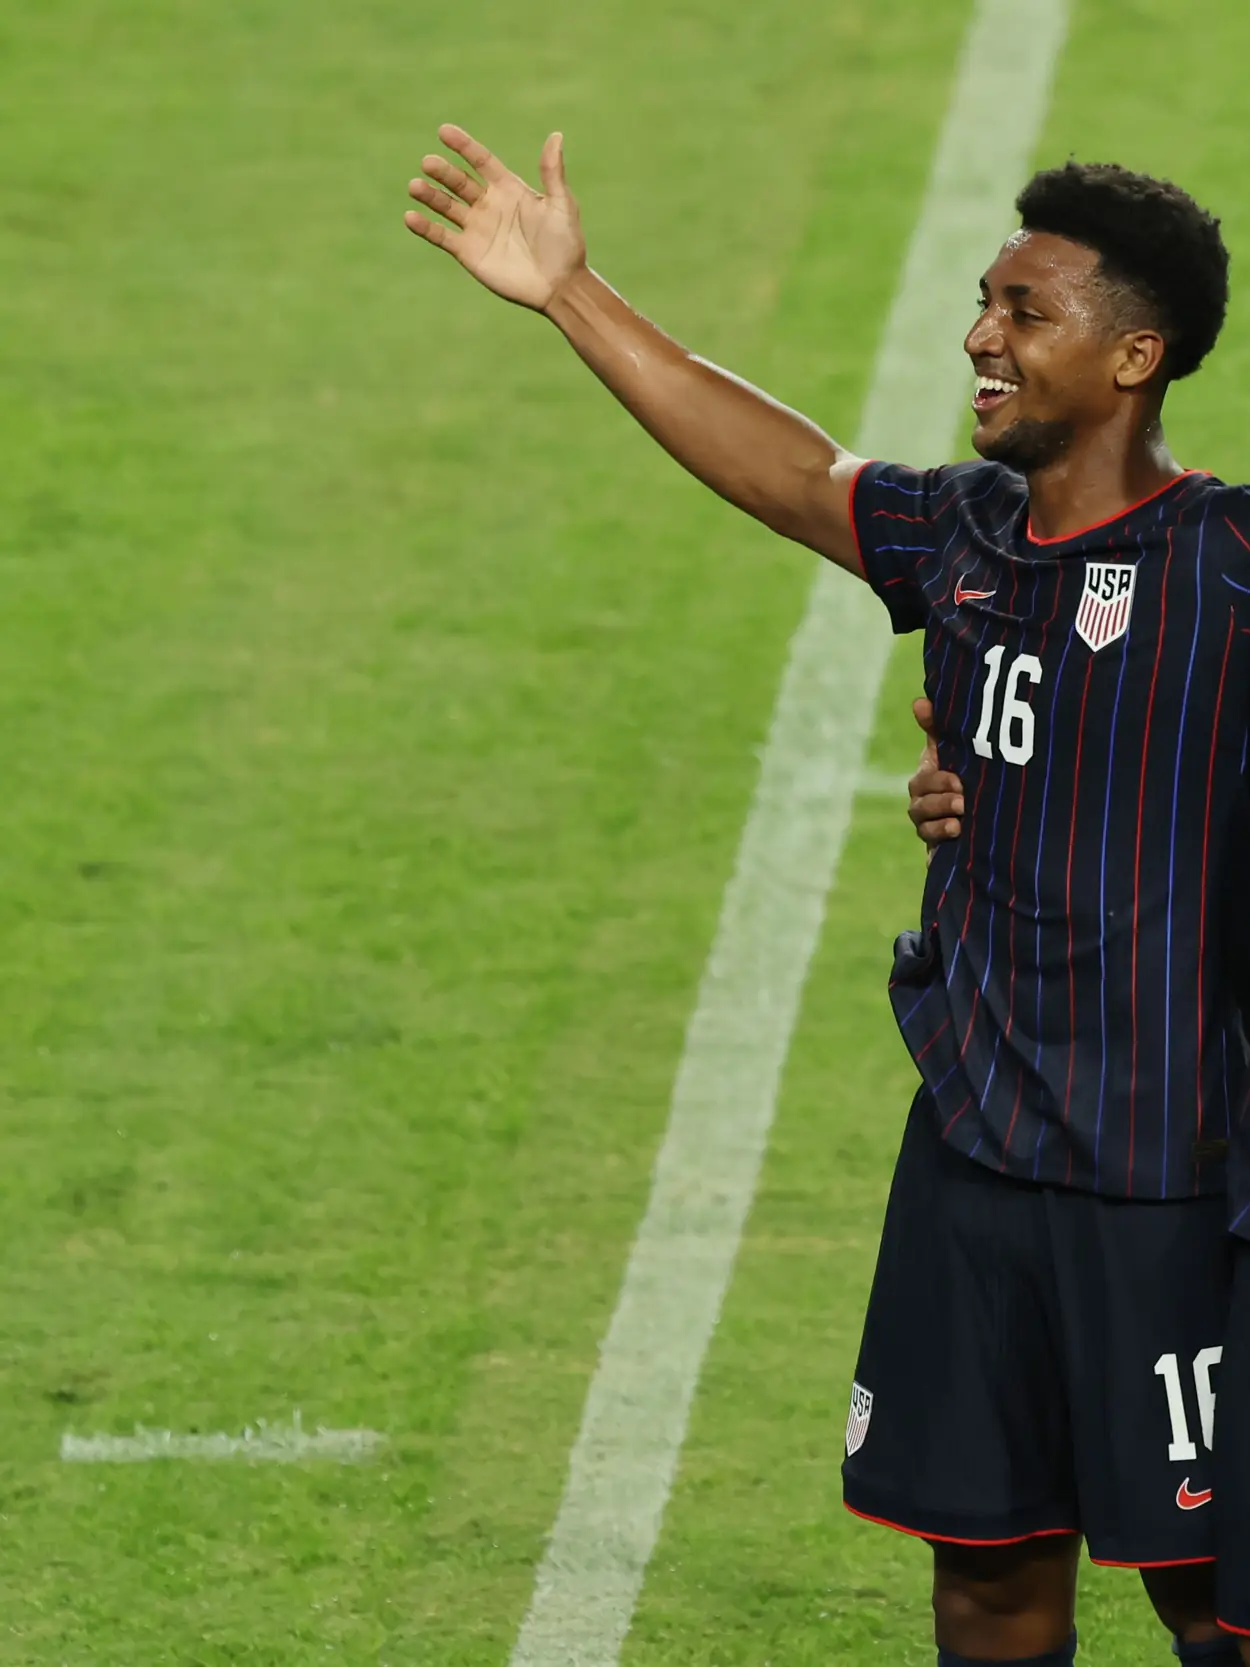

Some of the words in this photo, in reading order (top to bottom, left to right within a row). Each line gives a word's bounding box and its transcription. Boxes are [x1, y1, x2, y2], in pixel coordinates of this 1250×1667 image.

[1088, 567, 1132, 601] USA
[972, 645, 1043, 766] 16
[853, 1385, 871, 1417] USA
